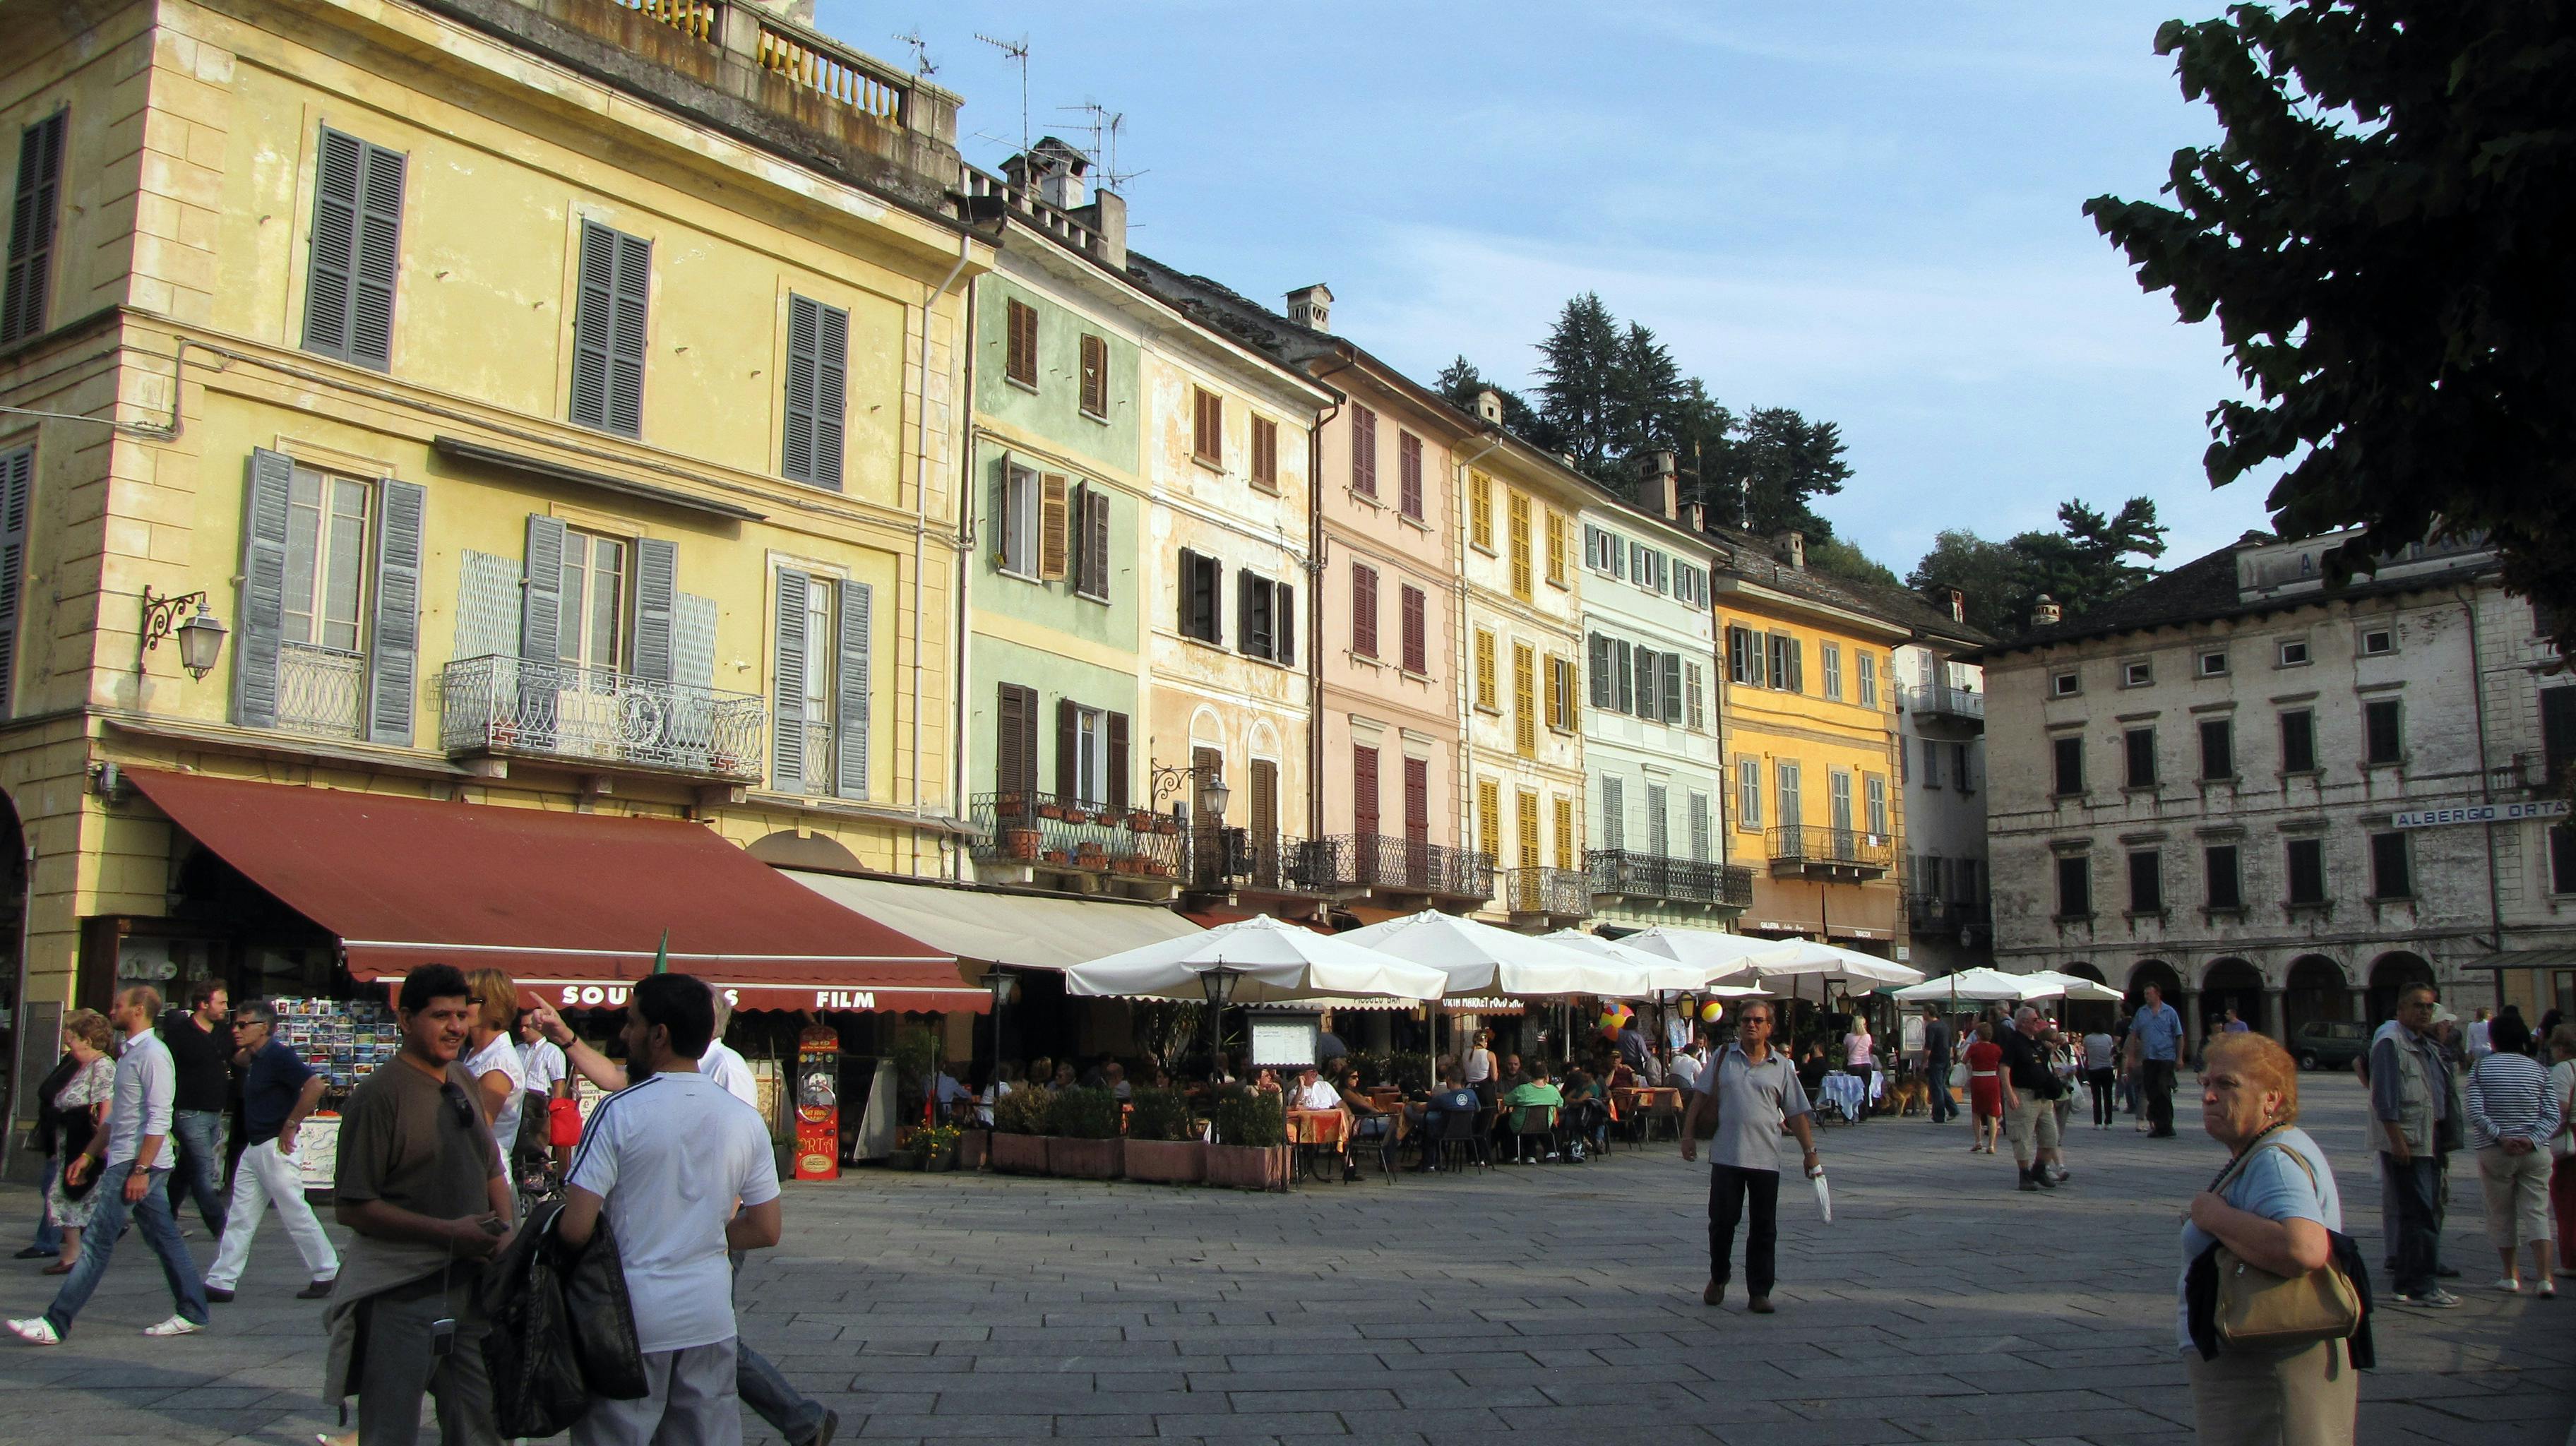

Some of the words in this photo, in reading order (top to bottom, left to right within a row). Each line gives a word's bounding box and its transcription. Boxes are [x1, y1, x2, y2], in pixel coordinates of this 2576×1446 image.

[2397, 806, 2495, 825] ALBERGO
[2508, 801, 2564, 817] ORTA
[816, 991, 875, 1008] FILM
